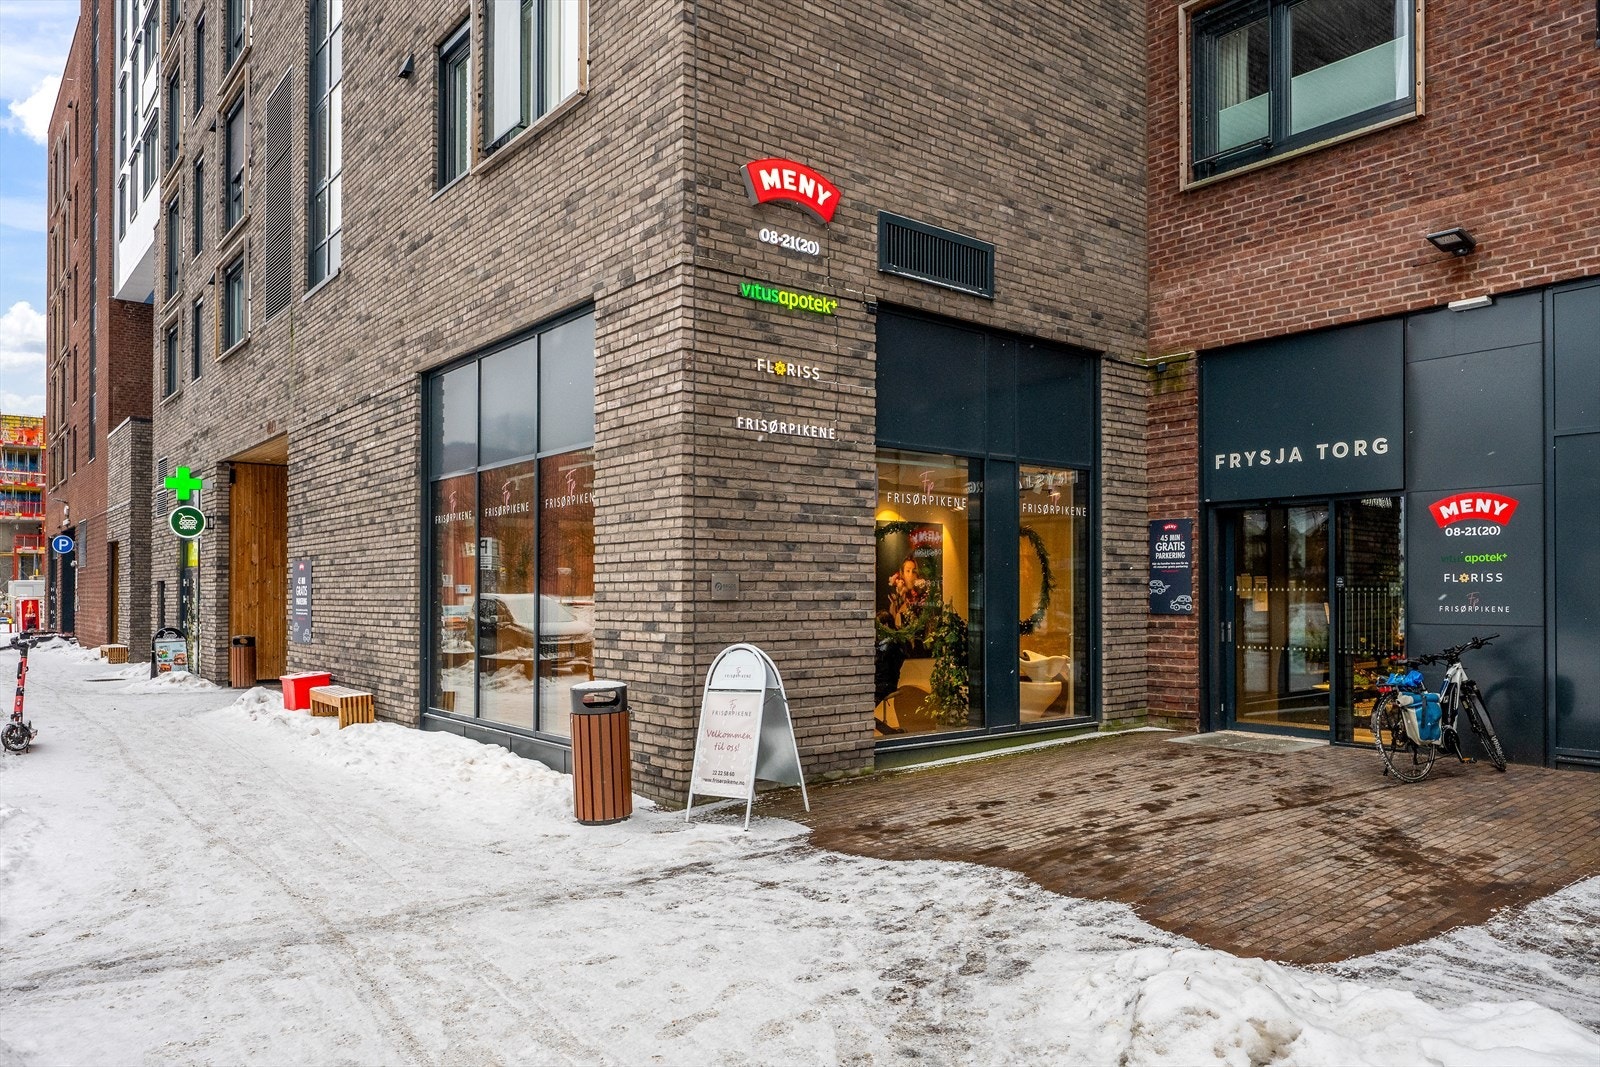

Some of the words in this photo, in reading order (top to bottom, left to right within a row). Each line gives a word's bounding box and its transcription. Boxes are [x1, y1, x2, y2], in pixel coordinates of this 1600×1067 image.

[759, 168, 832, 206] MENY
[759, 228, 819, 255] 08-21(20)
[737, 416, 835, 439] FRISØRPIKENE
[1215, 446, 1302, 470] FRYSJA
[1316, 437, 1389, 460] TORG
[545, 492, 595, 509] FRISØRPIKEN
[887, 491, 967, 509] FRISØRPIKENE
[485, 502, 529, 517] FRISØRPIKENE
[1022, 502, 1087, 517] FRISØRPIKENE
[1439, 498, 1509, 520] MENY
[435, 511, 472, 524] FRISØRPIKENE
[1445, 525, 1501, 537] 08-21(20)
[58, 537, 69, 550] P
[1155, 541, 1186, 552] GRATIS
[1155, 551, 1185, 559] PARKERING
[1439, 605, 1510, 613] FRISØRPIKENE
[706, 729, 752, 740] Velkommen
[714, 742, 725, 751] til
[726, 743, 740, 752] oss!
